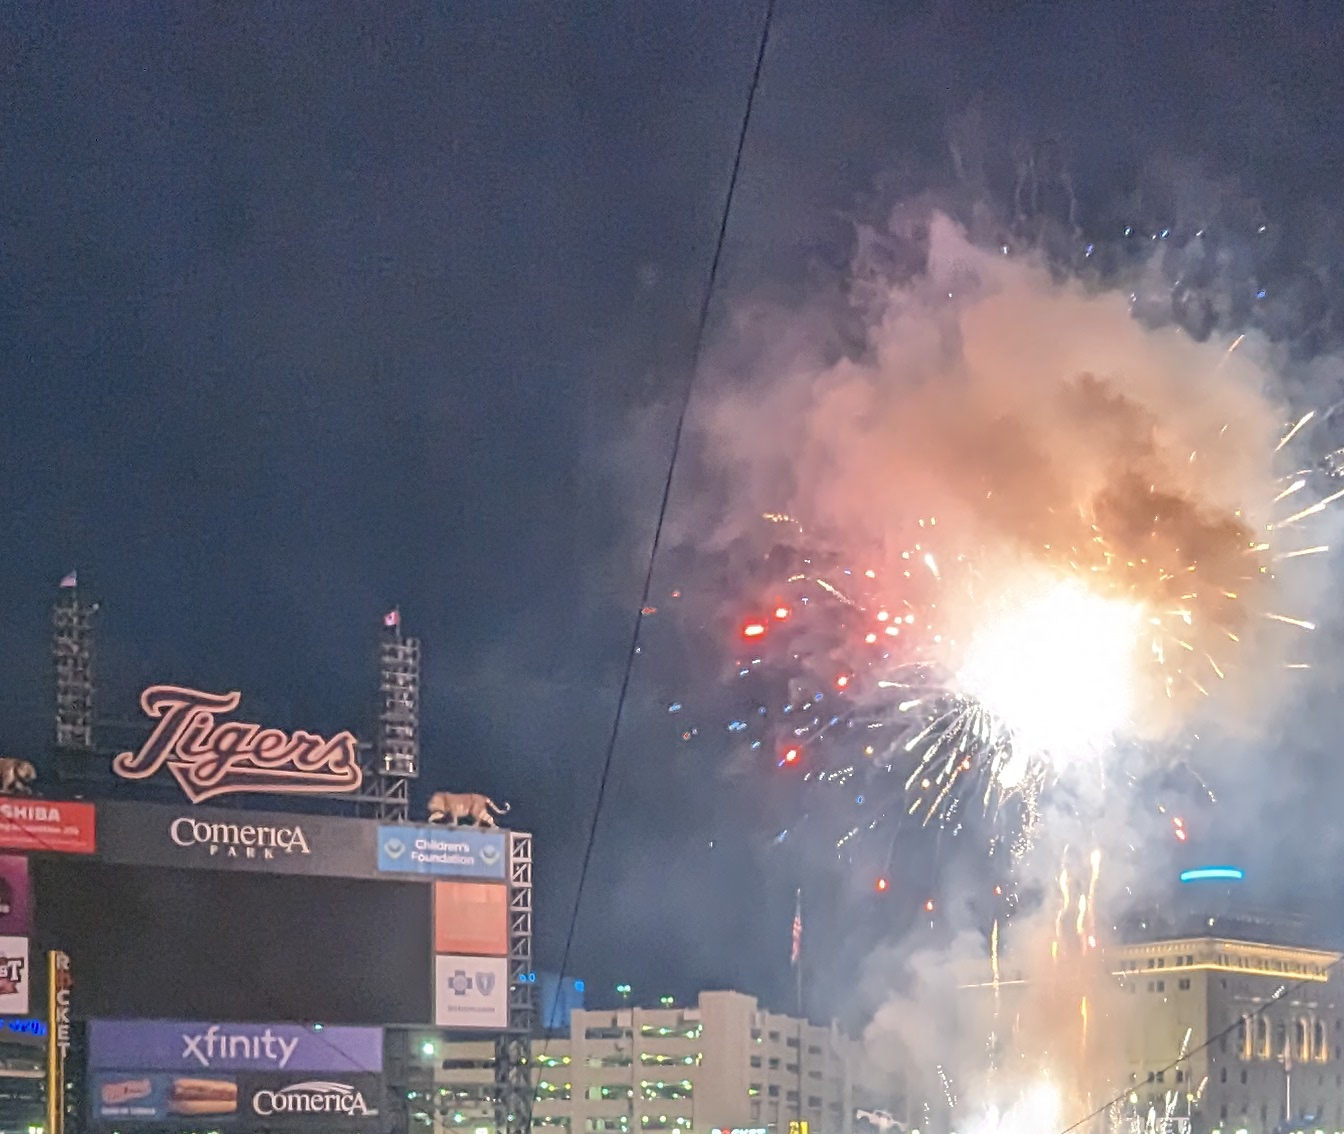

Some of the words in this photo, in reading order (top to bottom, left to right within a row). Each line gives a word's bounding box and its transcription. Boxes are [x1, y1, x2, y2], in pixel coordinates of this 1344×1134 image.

[113, 685, 362, 803] Tigers
[210, 846, 273, 858] PARK
[182, 1025, 298, 1068] xfinity
